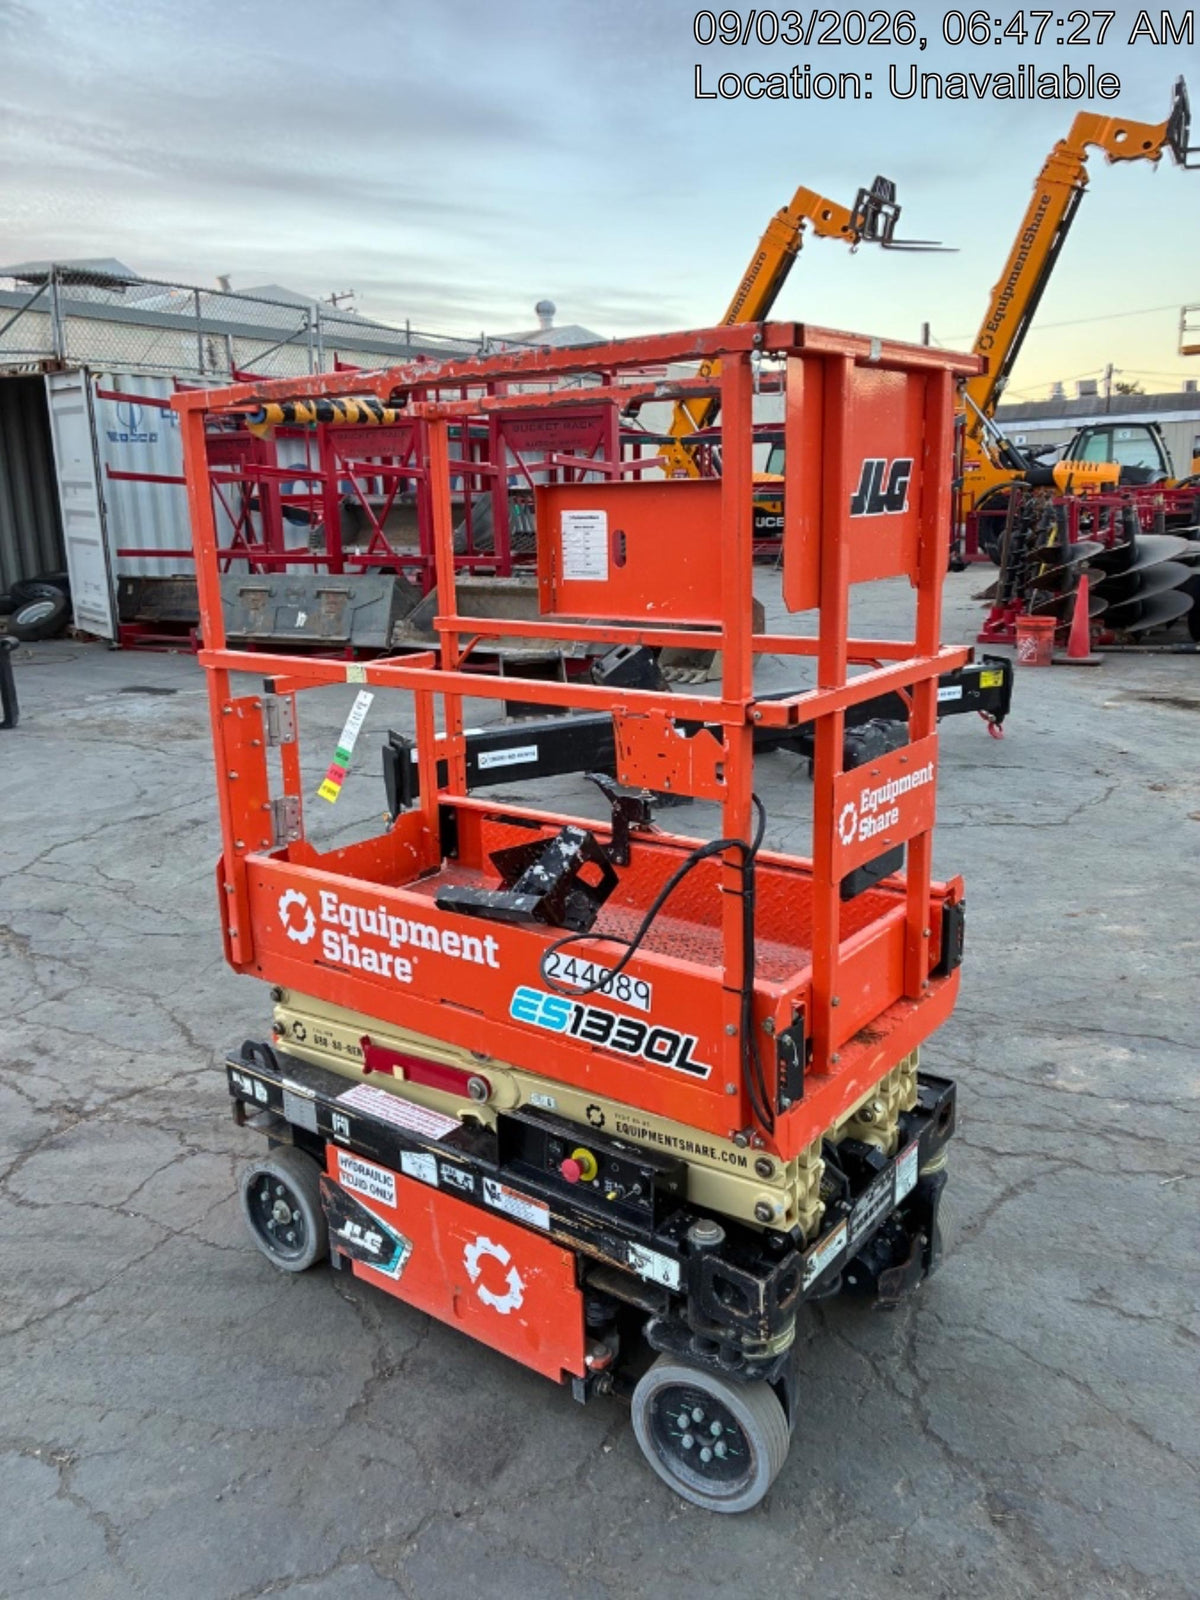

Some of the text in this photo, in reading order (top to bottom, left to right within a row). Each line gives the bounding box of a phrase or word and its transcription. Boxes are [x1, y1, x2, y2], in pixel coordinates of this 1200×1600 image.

[986, 194, 1051, 333] EquipmentShare
[850, 459, 913, 517] JLG
[861, 761, 935, 814] Equipment
[859, 807, 899, 841] Share
[319, 890, 500, 969] Equipment
[322, 929, 413, 984] Share
[546, 953, 651, 1011] 244089
[510, 986, 711, 1079] ES1330L
[339, 1157, 394, 1187] HYDRAULIC
[616, 1121, 748, 1168] EQUIPMENTSHARE.COM
[369, 1182, 394, 1202] ONLY
